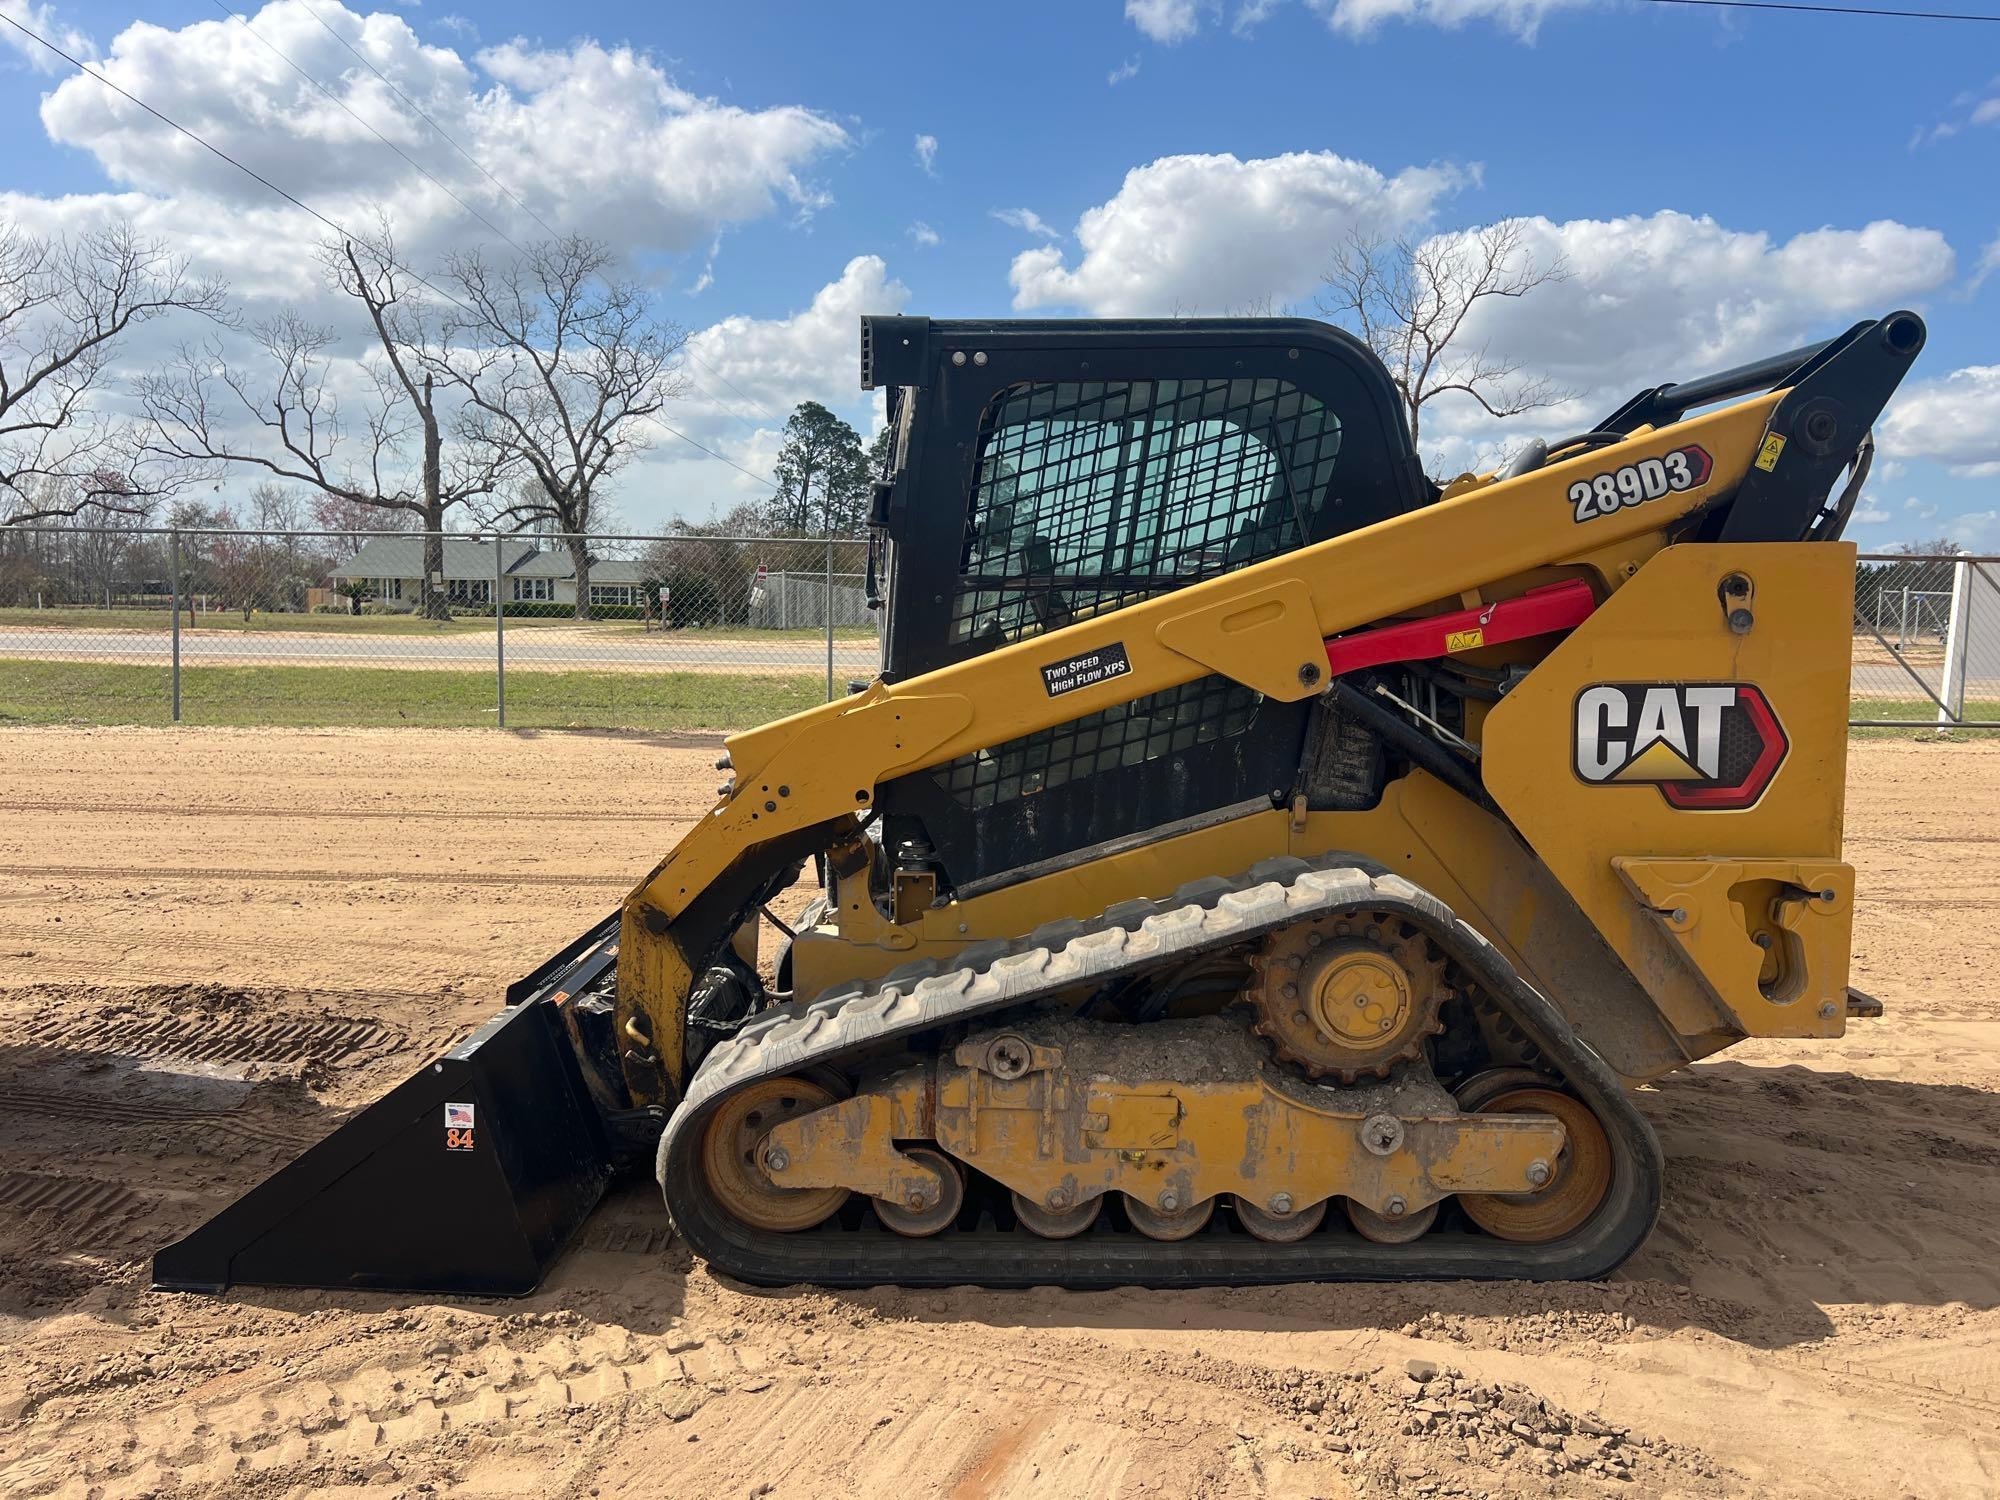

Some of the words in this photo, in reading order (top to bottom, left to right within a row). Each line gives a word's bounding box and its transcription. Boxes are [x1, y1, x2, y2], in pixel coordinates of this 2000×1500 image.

[1569, 451, 1692, 521] 289D3
[1045, 665, 1067, 681] TWO
[1069, 656, 1099, 673] SPEED
[1051, 677, 1075, 694] HIGH
[1076, 669, 1102, 685] FLOW
[1104, 660, 1126, 677] XPS
[1577, 686, 1736, 781] CAT
[446, 1128, 474, 1149] 84
